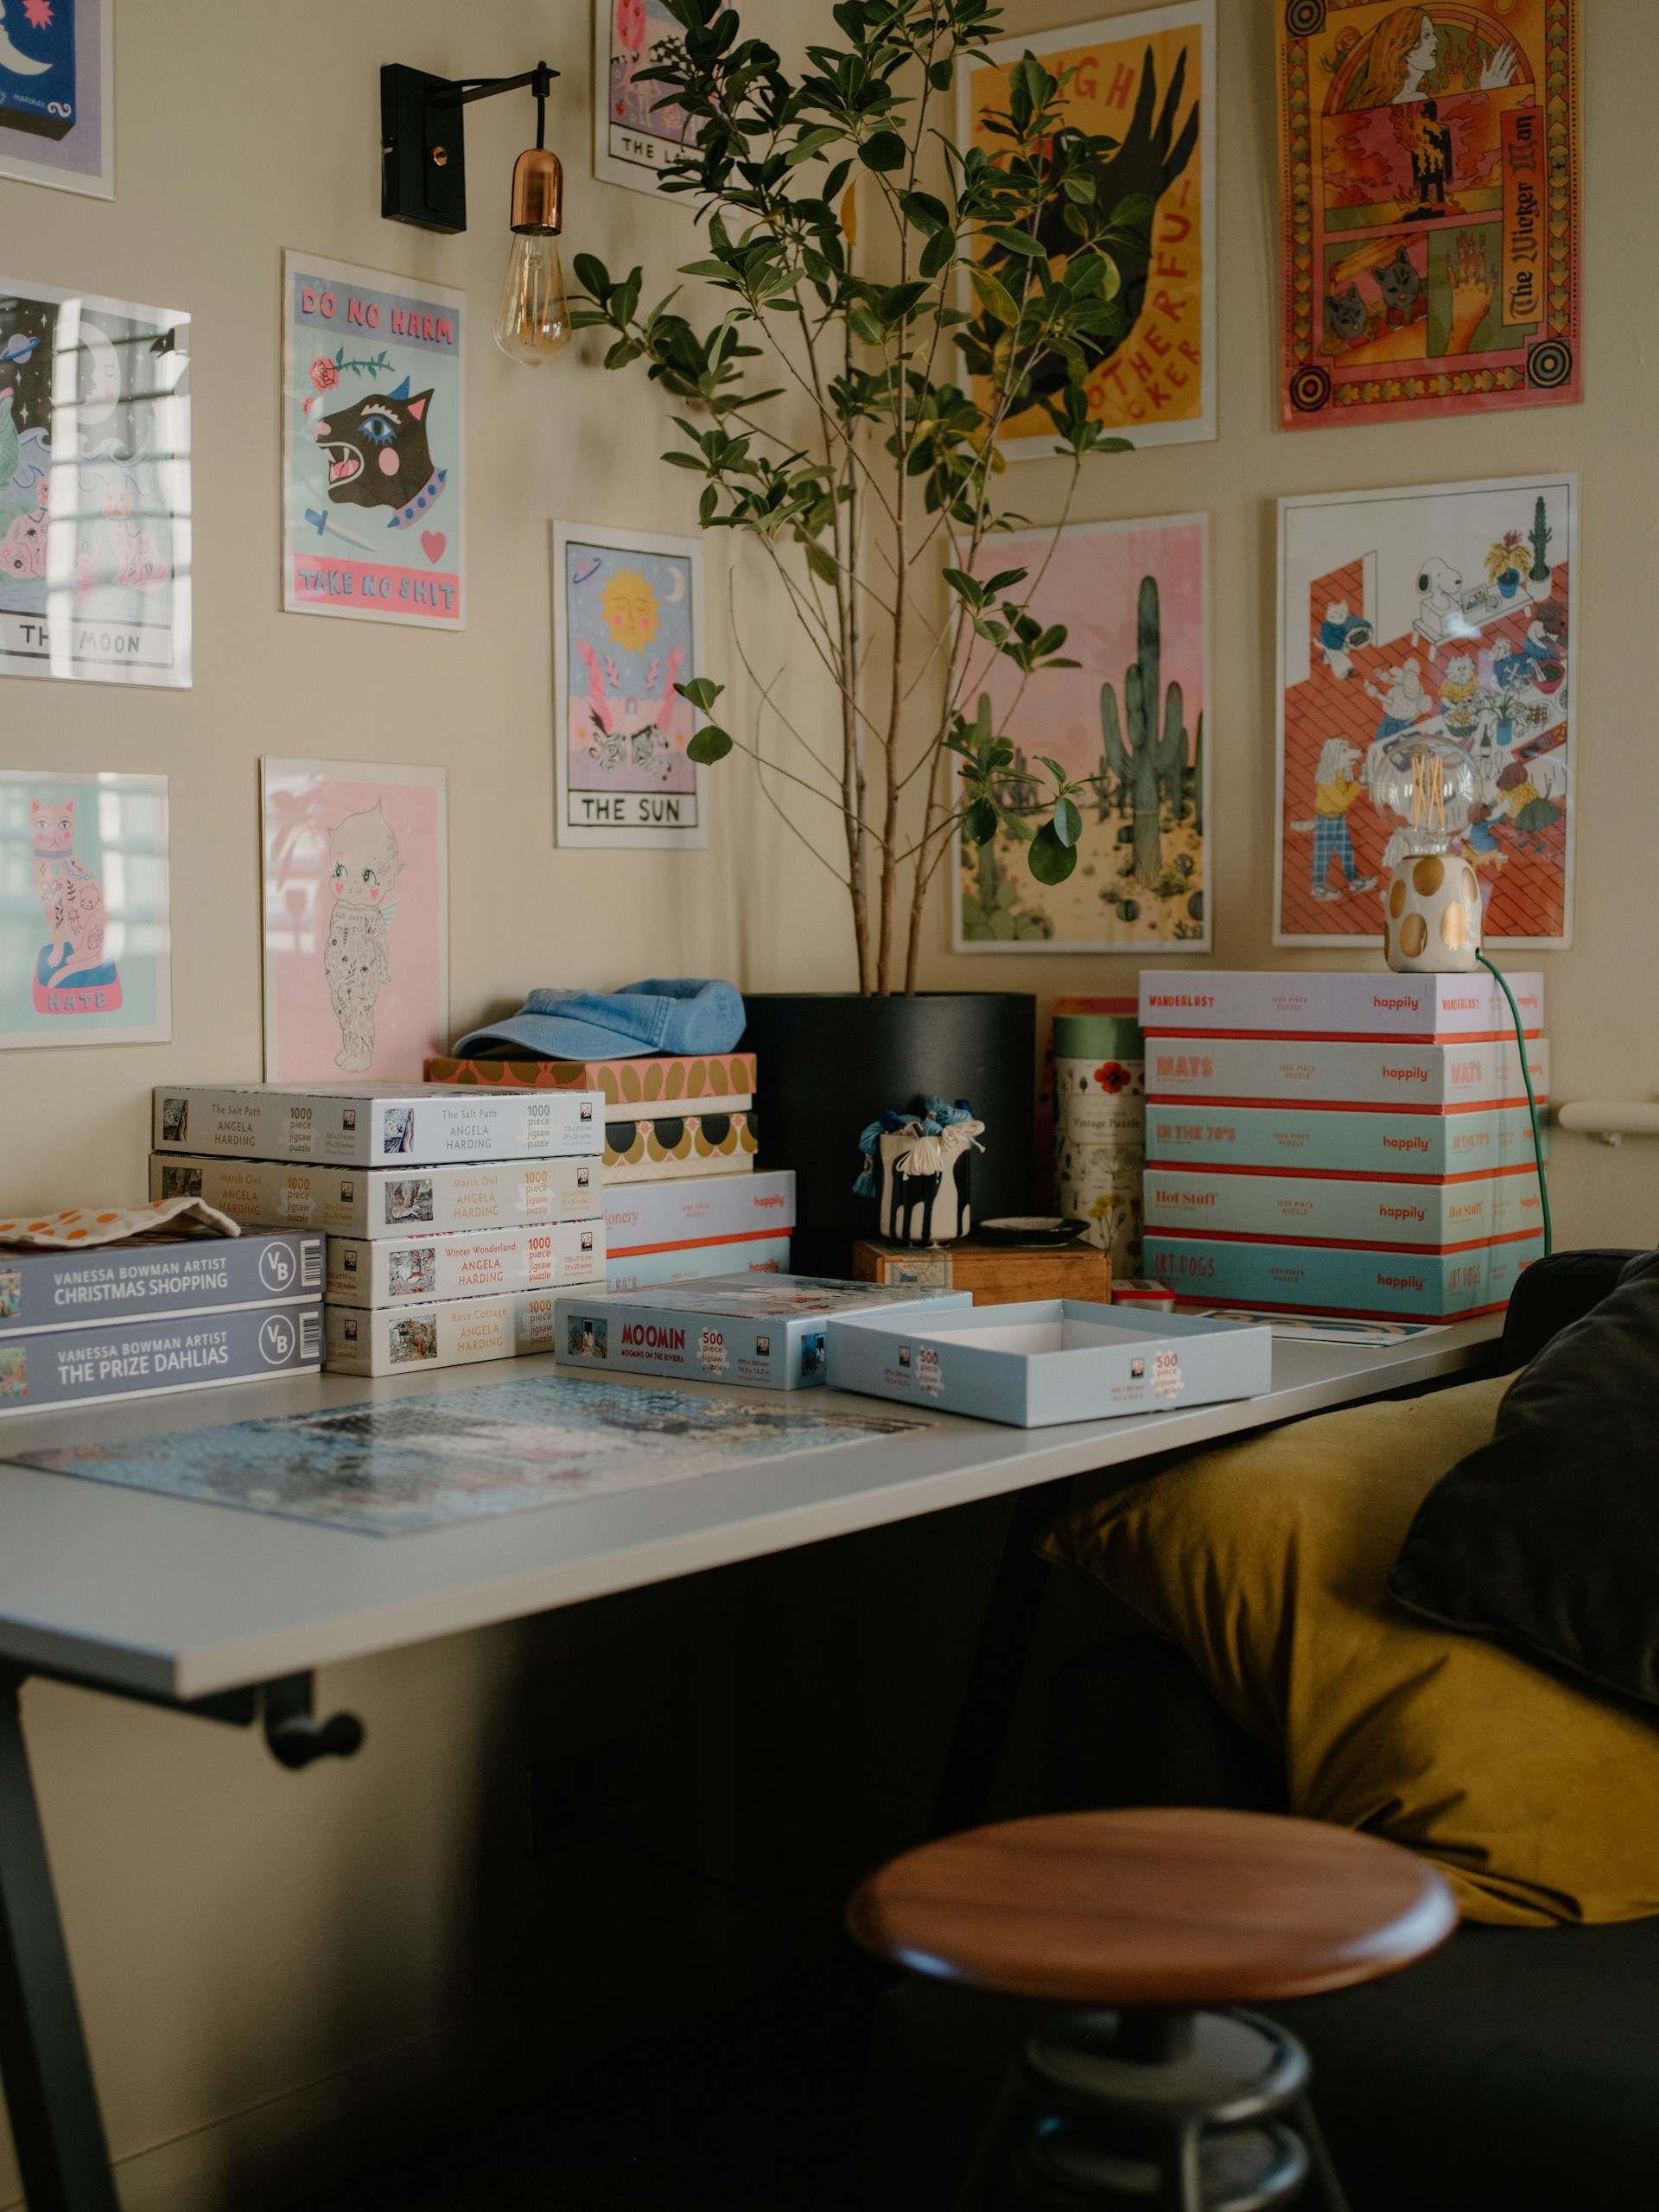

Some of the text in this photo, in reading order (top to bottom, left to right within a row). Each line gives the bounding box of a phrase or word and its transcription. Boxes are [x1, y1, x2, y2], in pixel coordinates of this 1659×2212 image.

[1056, 56, 1136, 110] IGH
[622, 137, 654, 159] THE
[1508, 114, 1540, 320] The Wicker Man
[302, 287, 453, 344] DO NO HARM
[298, 569, 455, 609] TAKE NO SHIT
[19, 624, 140, 654] TH MOON
[582, 798, 679, 822] THE SUN
[48, 992, 105, 1010] HATE
[1148, 995, 1215, 1007] WANDERLUST
[1373, 995, 1419, 1011] happily
[1442, 998, 1479, 1010] WANDERLUST
[1156, 1056, 1213, 1077] MATS
[1452, 1061, 1482, 1084] MATS
[1382, 1065, 1428, 1082] happily
[212, 1104, 261, 1116] The Salt Path
[289, 1107, 312, 1120] 1000
[442, 1108, 497, 1119] The Salt Path
[527, 1104, 550, 1116] 1000
[217, 1122, 253, 1133] ANGELA
[289, 1120, 312, 1131] piece
[528, 1116, 550, 1128] piece
[1073, 1118, 1141, 1129] Vintage Puzzle
[289, 1131, 312, 1143] jigsaw
[449, 1125, 489, 1136] ANGELA
[527, 1128, 550, 1140] jigsaw
[1156, 1125, 1172, 1139] IN
[1174, 1125, 1204, 1140] THE
[214, 1135, 255, 1147] HARDING
[446, 1138, 492, 1150] HARDING
[527, 1139, 550, 1149] puzzle
[1383, 1135, 1428, 1152] happily
[289, 1142, 311, 1154] puzzle
[220, 1173, 261, 1185] Marsh Owl
[287, 1177, 309, 1190] 1000
[454, 1175, 498, 1188] Marsh Owl
[524, 1171, 547, 1184] 1000
[222, 1189, 257, 1201] ANGELA
[287, 1189, 309, 1200] piece
[525, 1183, 547, 1195] piece
[456, 1192, 495, 1205] ANGELA
[525, 1196, 548, 1207] jigsaw
[754, 1194, 785, 1209] happily
[1156, 1190, 1217, 1205] Hot Stuff
[219, 1203, 260, 1216] HARDING
[286, 1201, 309, 1213] jigsaw
[454, 1205, 499, 1218] HARDING
[526, 1205, 548, 1217] puzzle
[1380, 1205, 1425, 1222] happily
[1450, 1205, 1462, 1218] Hot
[1464, 1201, 1482, 1217] Stuff
[287, 1213, 309, 1224] puzzle
[528, 1236, 550, 1249] 1000
[445, 1242, 516, 1257] Winter Wonderland
[529, 1249, 551, 1261] piece
[54, 1257, 227, 1286] VANESSA BOWMAN ARTIST
[267, 1251, 289, 1281] VB
[461, 1259, 500, 1272] ANGELA
[529, 1262, 551, 1273] jigsaw
[749, 1258, 780, 1273] happily
[1154, 1253, 1215, 1277] ART DOGS
[459, 1271, 503, 1286] HARDING
[529, 1272, 551, 1283] puzzle
[1377, 1273, 1423, 1291] happily
[1449, 1268, 1461, 1290] ART
[1463, 1264, 1481, 1287] DOGS
[54, 1273, 228, 1306] CHRISTMAS SHOPPING
[529, 1300, 551, 1313] 1000
[452, 1308, 507, 1322] Rose Cottage
[530, 1312, 552, 1324] piece
[460, 1324, 499, 1338] ANGELA
[531, 1324, 553, 1336] jigsaw
[621, 1322, 685, 1351] MOOMIN
[267, 1325, 288, 1354] VB
[458, 1337, 503, 1352] HARDING
[531, 1334, 553, 1347] puzzle
[702, 1332, 723, 1344] 500
[57, 1332, 227, 1363] VANESSA BOWMAN ARTIST
[702, 1344, 723, 1353] piece
[621, 1349, 644, 1358] MOOMINS
[654, 1352, 663, 1361] THE
[664, 1354, 684, 1363] RIVIERA
[702, 1355, 722, 1363] jigsaw
[920, 1350, 938, 1365] 500
[1157, 1354, 1178, 1368] 500
[57, 1346, 229, 1385] THE PRIZE DAHLIAS
[1157, 1368, 1177, 1376] piece
